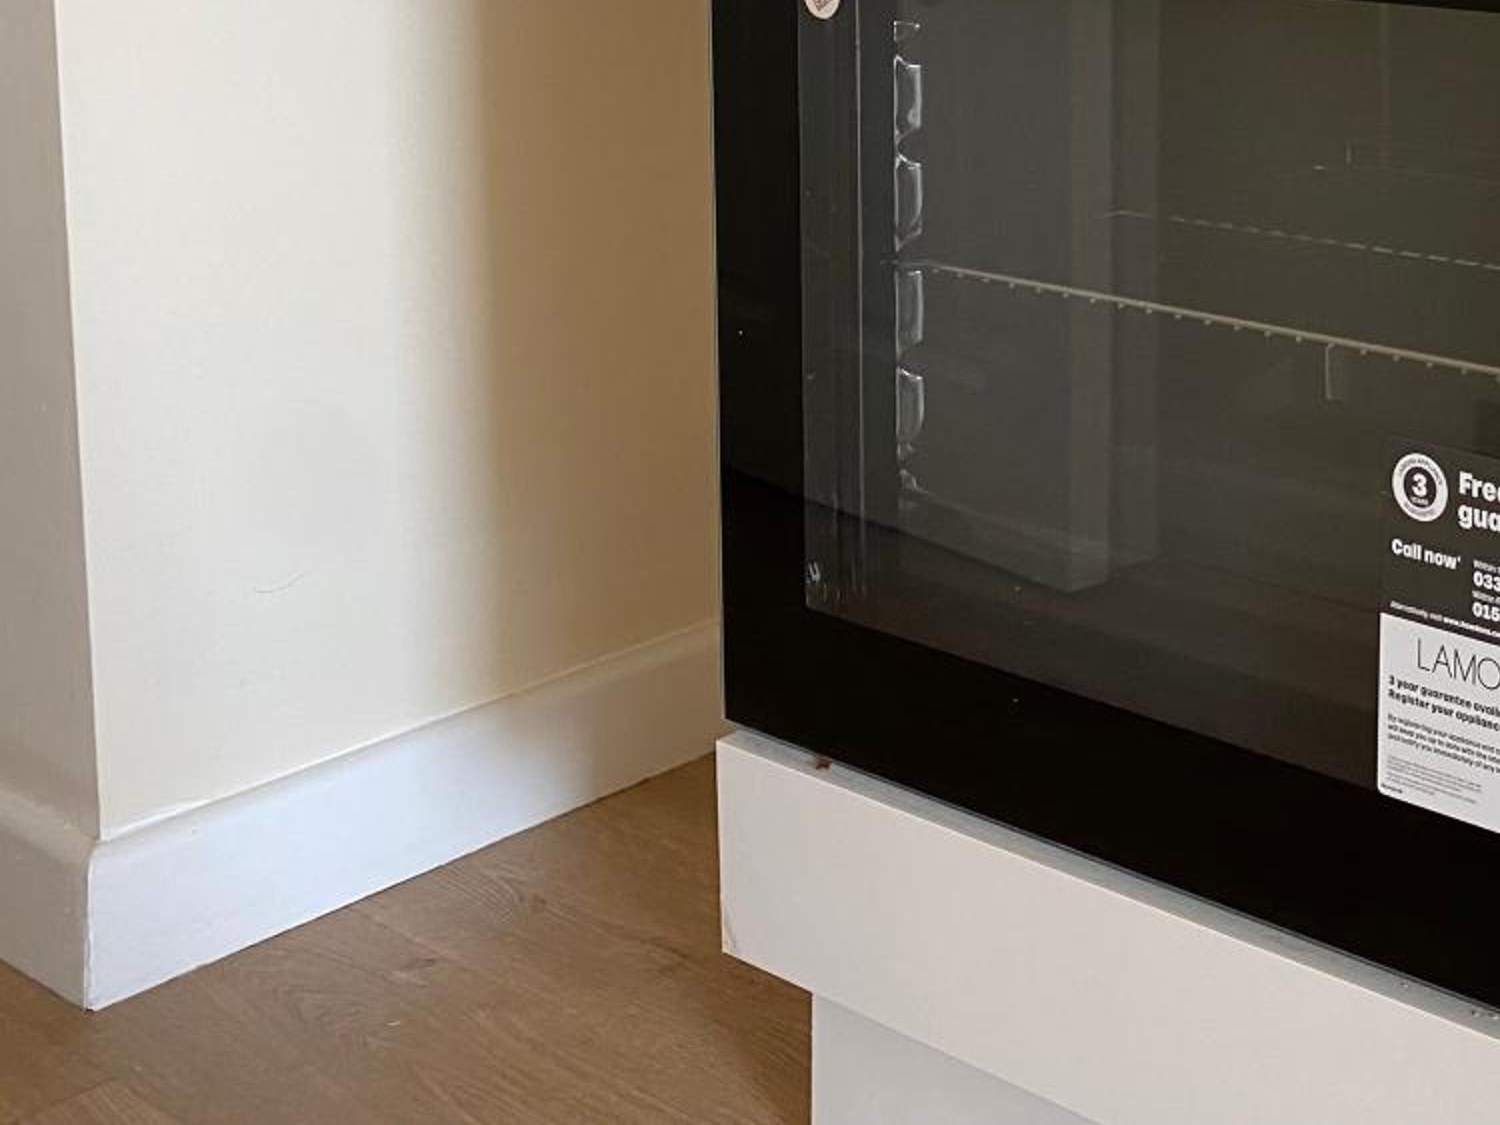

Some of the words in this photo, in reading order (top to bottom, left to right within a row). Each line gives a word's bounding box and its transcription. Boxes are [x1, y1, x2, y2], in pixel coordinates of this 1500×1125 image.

[1411, 472, 1428, 497] 3
[1391, 538, 1422, 561] Call
[1388, 688, 1430, 709] Register
[1431, 704, 1454, 717] your
[1396, 678, 1419, 692] year
[1421, 686, 1472, 710] guarantee
